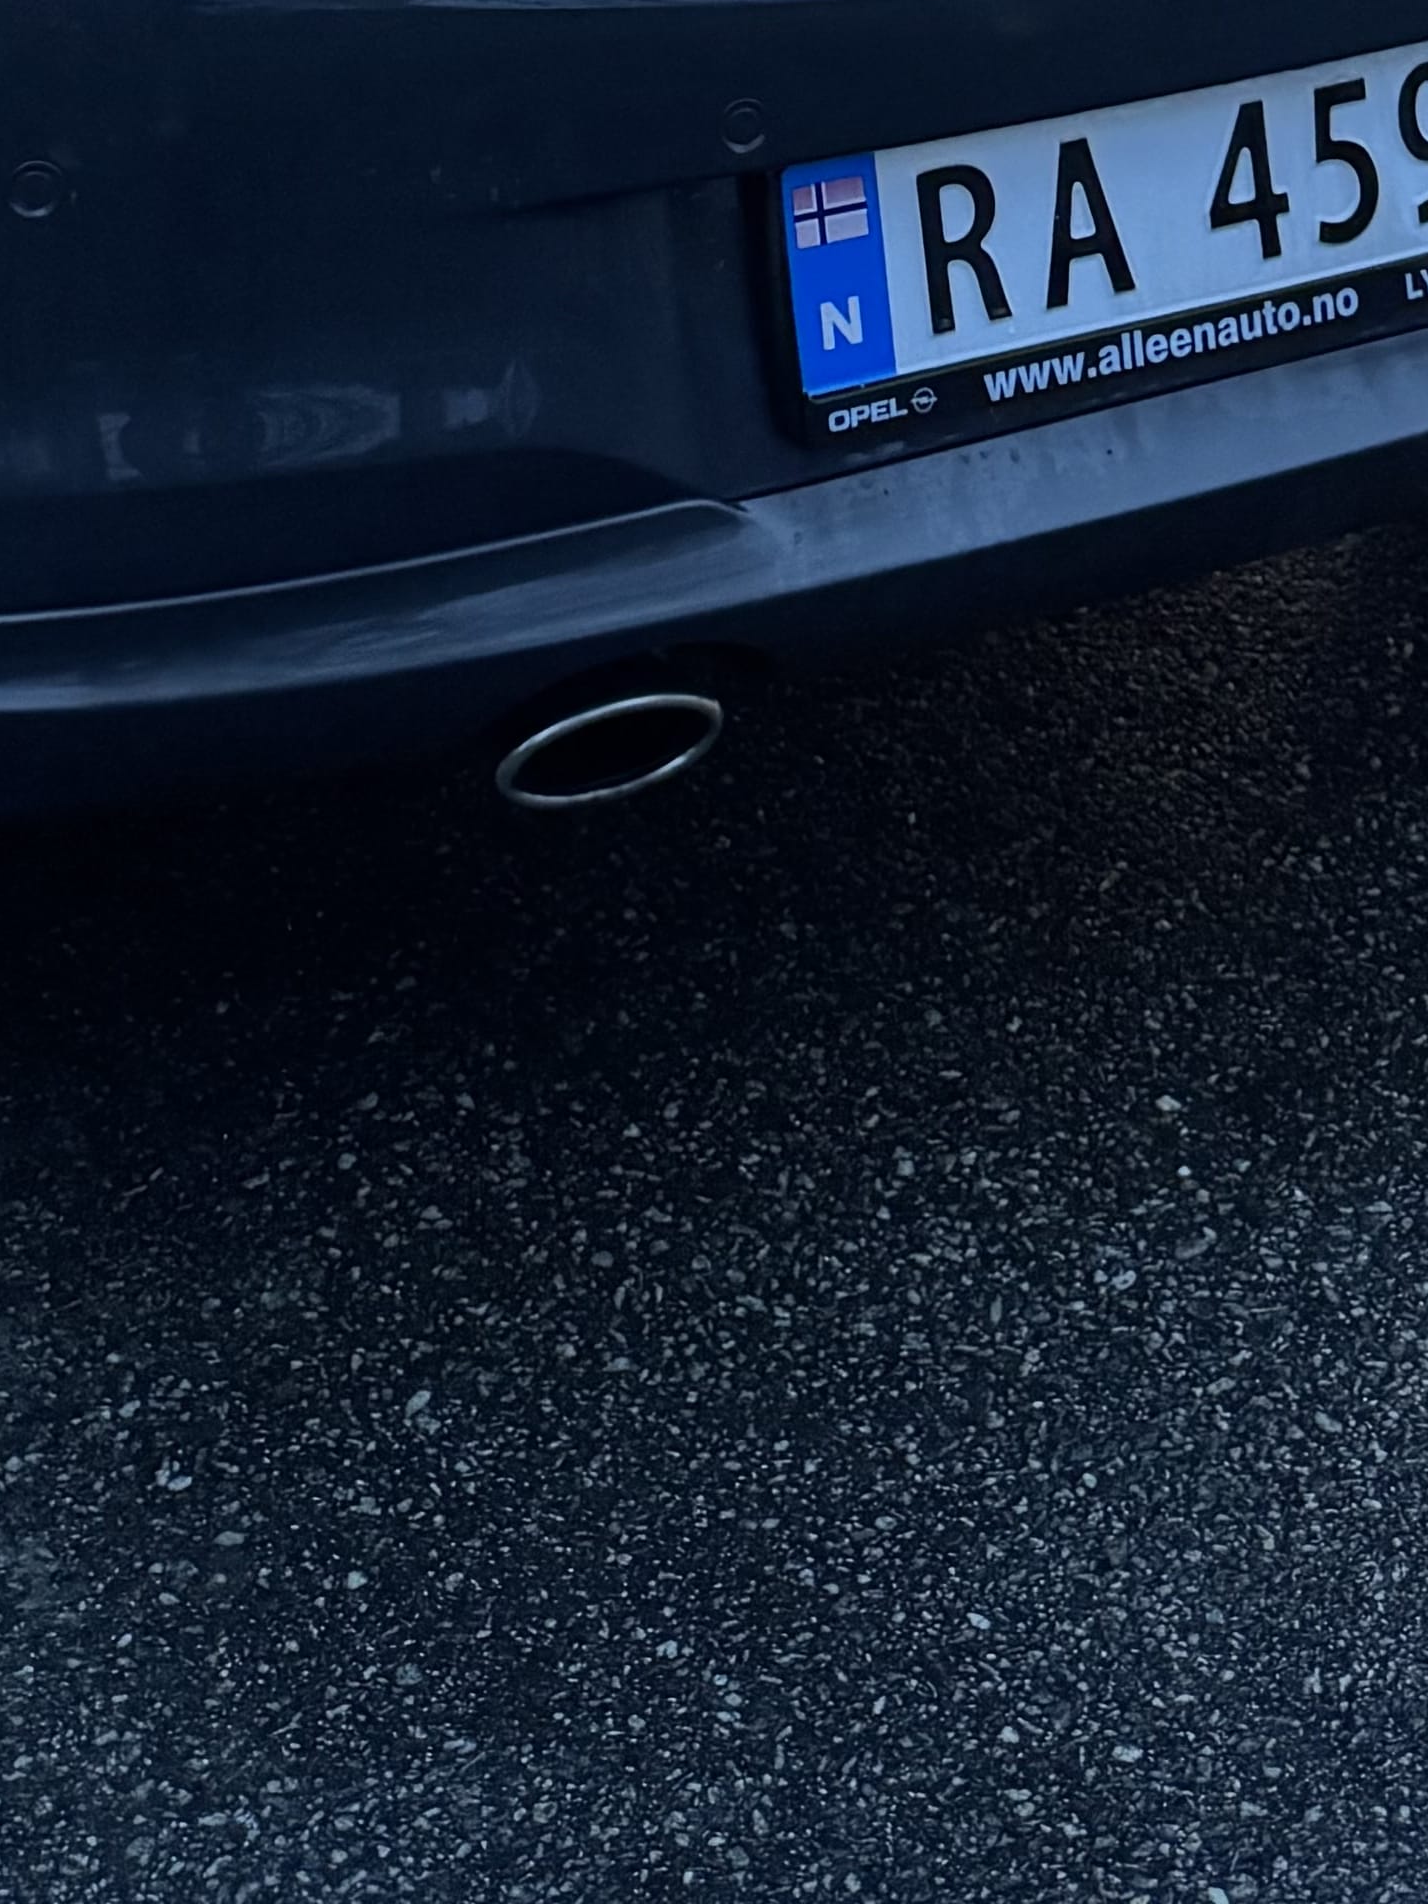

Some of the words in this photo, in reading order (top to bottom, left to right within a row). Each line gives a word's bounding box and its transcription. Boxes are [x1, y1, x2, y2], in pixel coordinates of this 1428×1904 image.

[915, 137, 1136, 335] RA
[819, 296, 863, 350] N
[984, 287, 1360, 402] www.alleenauto.no
[828, 397, 908, 433] OPEL
